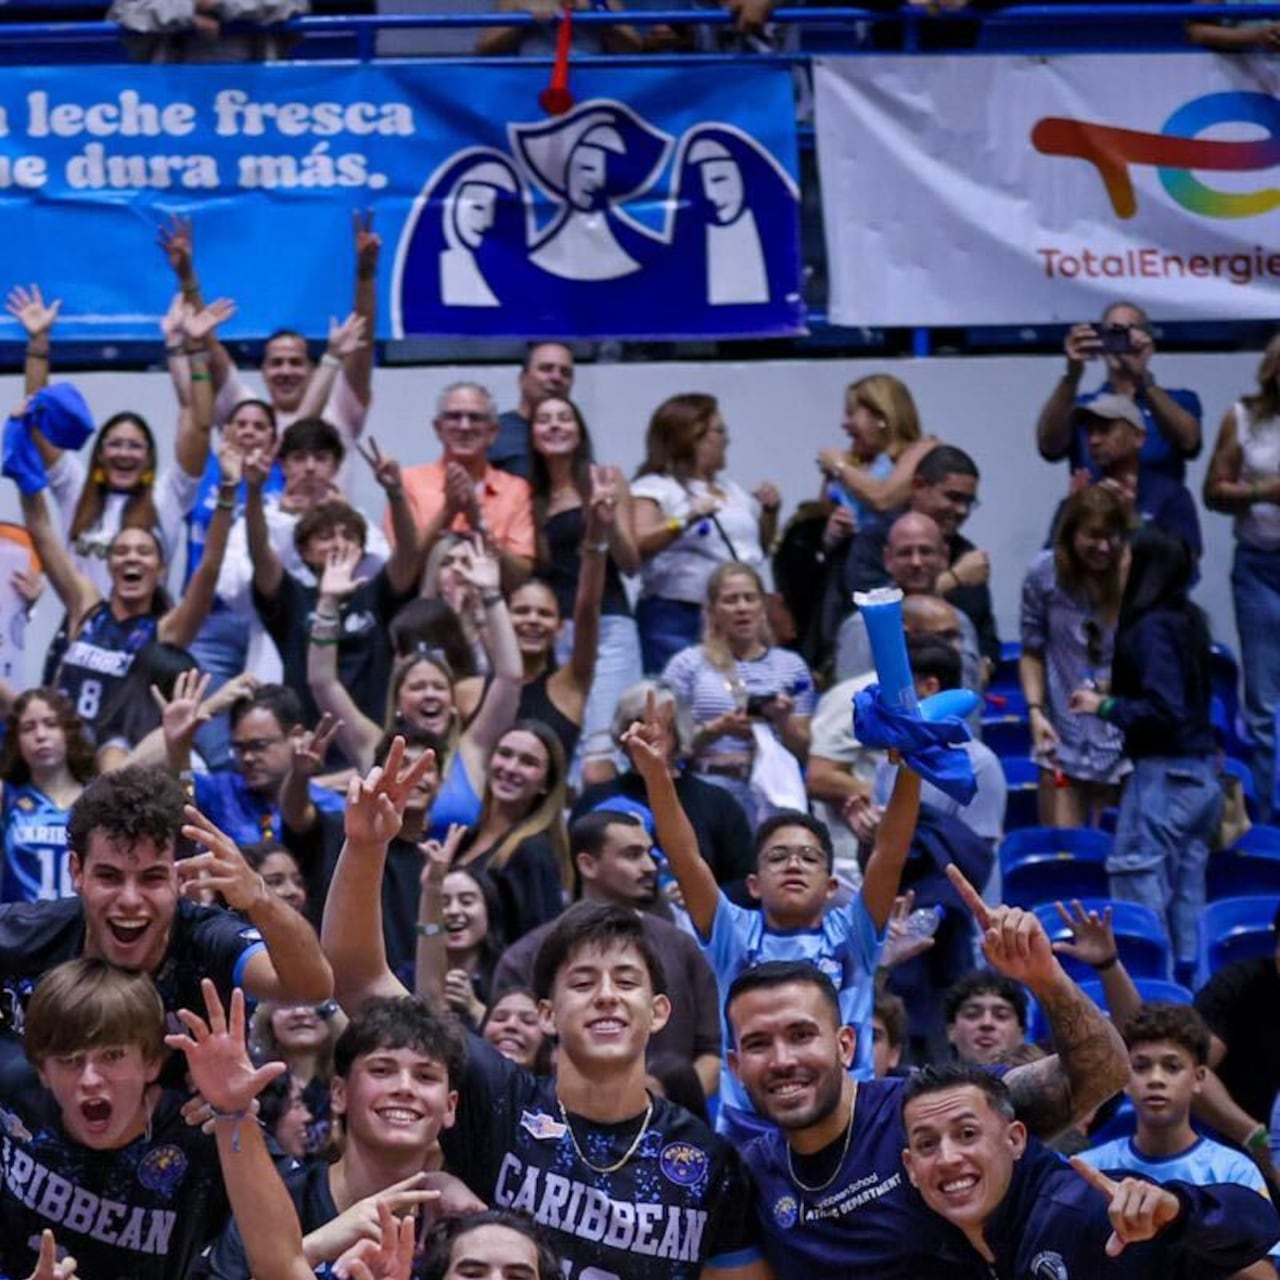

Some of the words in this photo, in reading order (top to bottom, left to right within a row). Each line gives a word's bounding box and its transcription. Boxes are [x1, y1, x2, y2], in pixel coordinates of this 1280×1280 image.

[28, 90, 195, 136] leche
[214, 89, 416, 136] fresca
[65, 143, 219, 190] dura
[238, 142, 388, 189] más.
[77, 679, 102, 719] 8
[495, 1151, 708, 1264] CARIBBEAN
